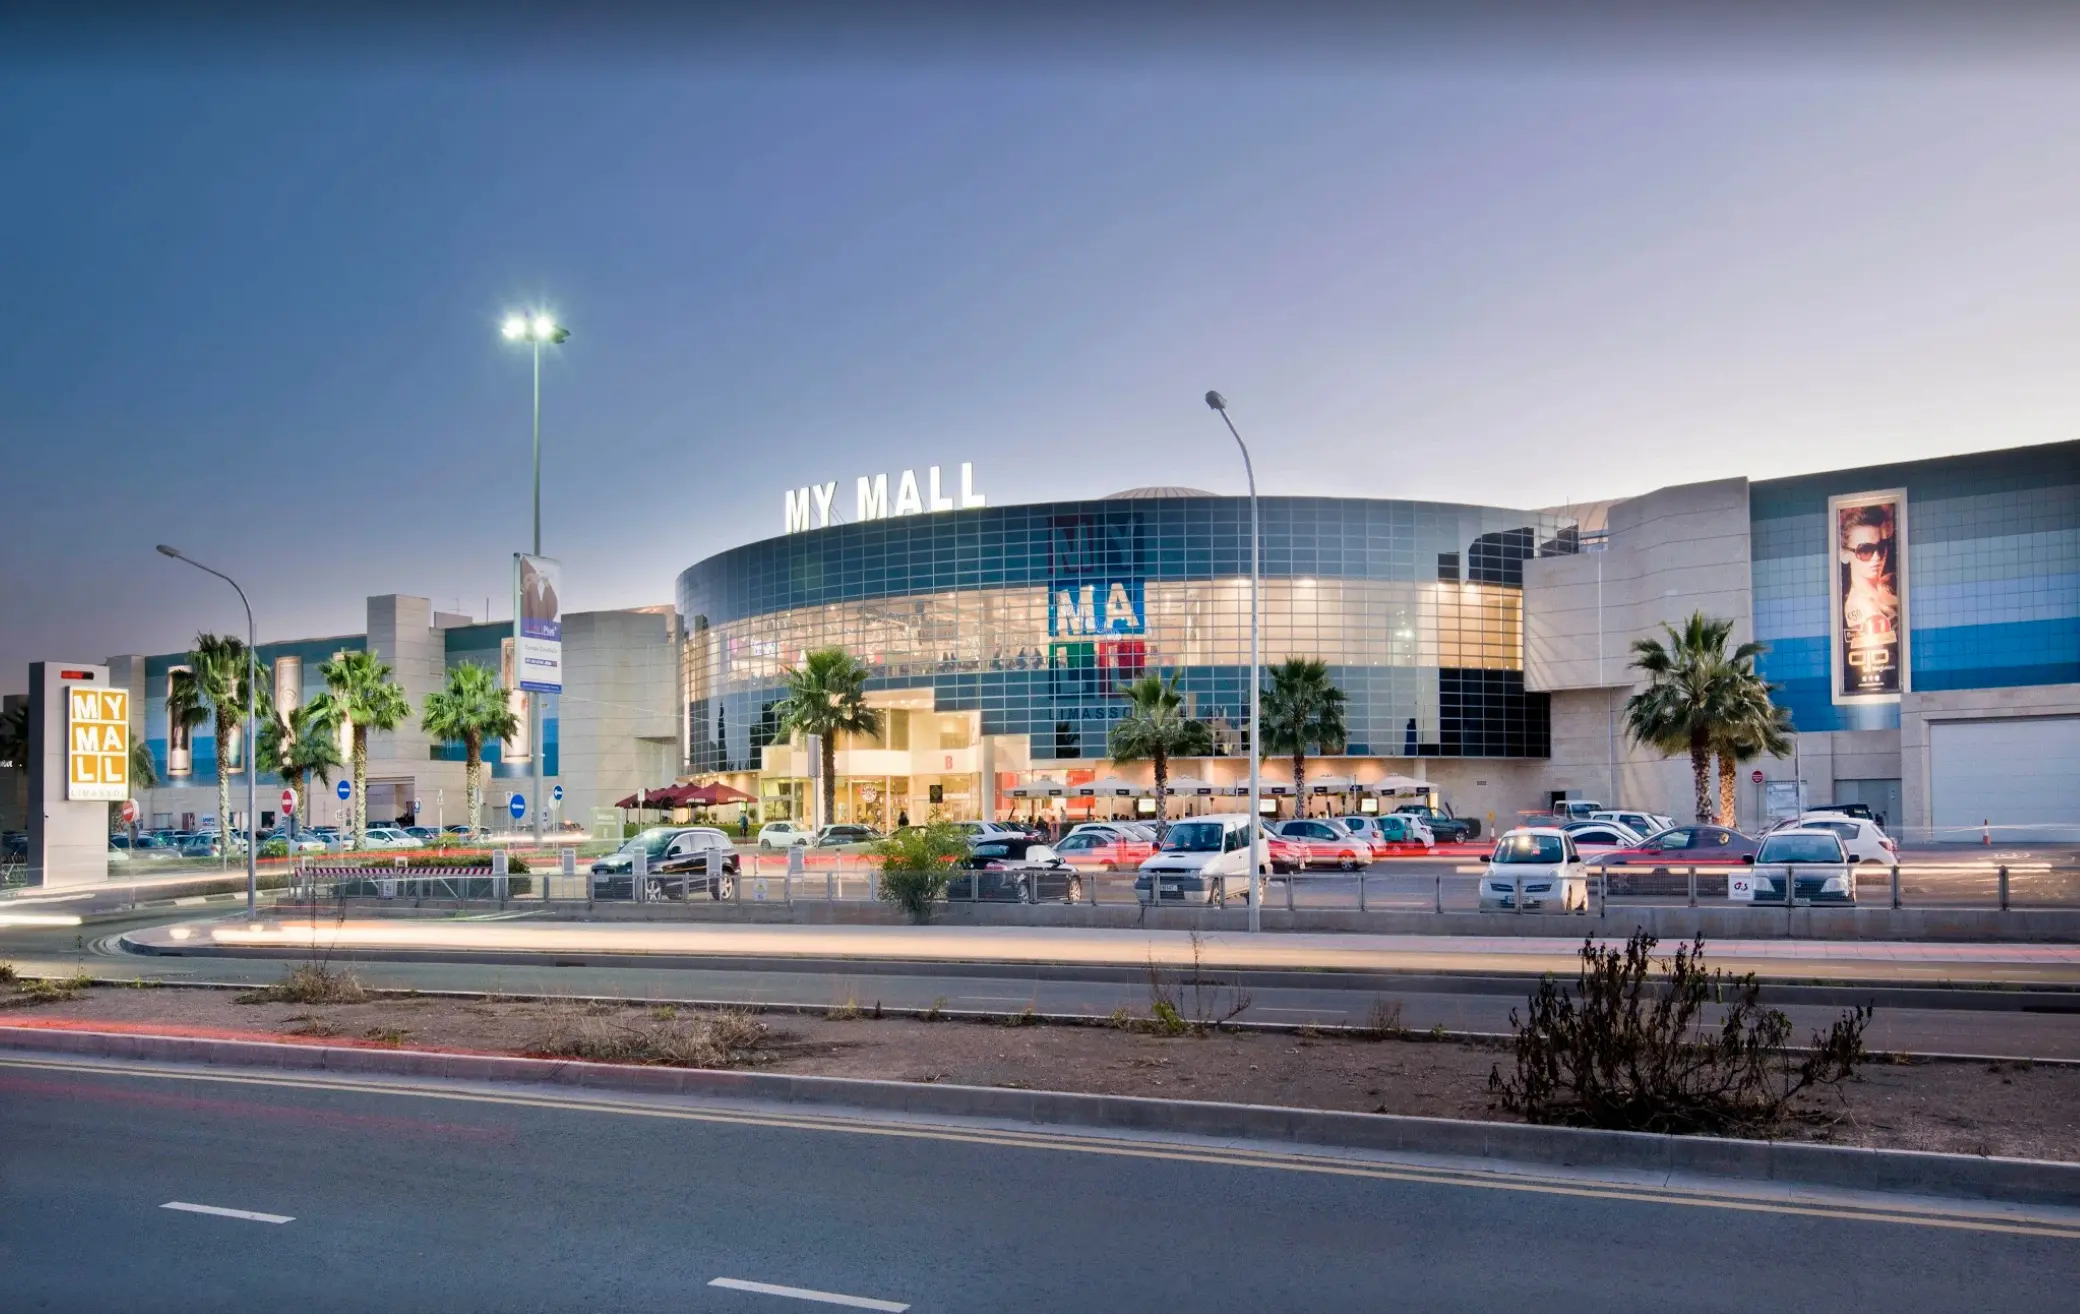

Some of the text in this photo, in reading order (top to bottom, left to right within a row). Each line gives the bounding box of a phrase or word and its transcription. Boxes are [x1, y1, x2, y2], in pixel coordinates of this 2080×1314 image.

[785, 461, 987, 534] MY MALL
[73, 694, 124, 719] MY
[1048, 706, 1133, 720] LIMASSO
[75, 725, 124, 751] MA
[945, 755, 953, 769] B
